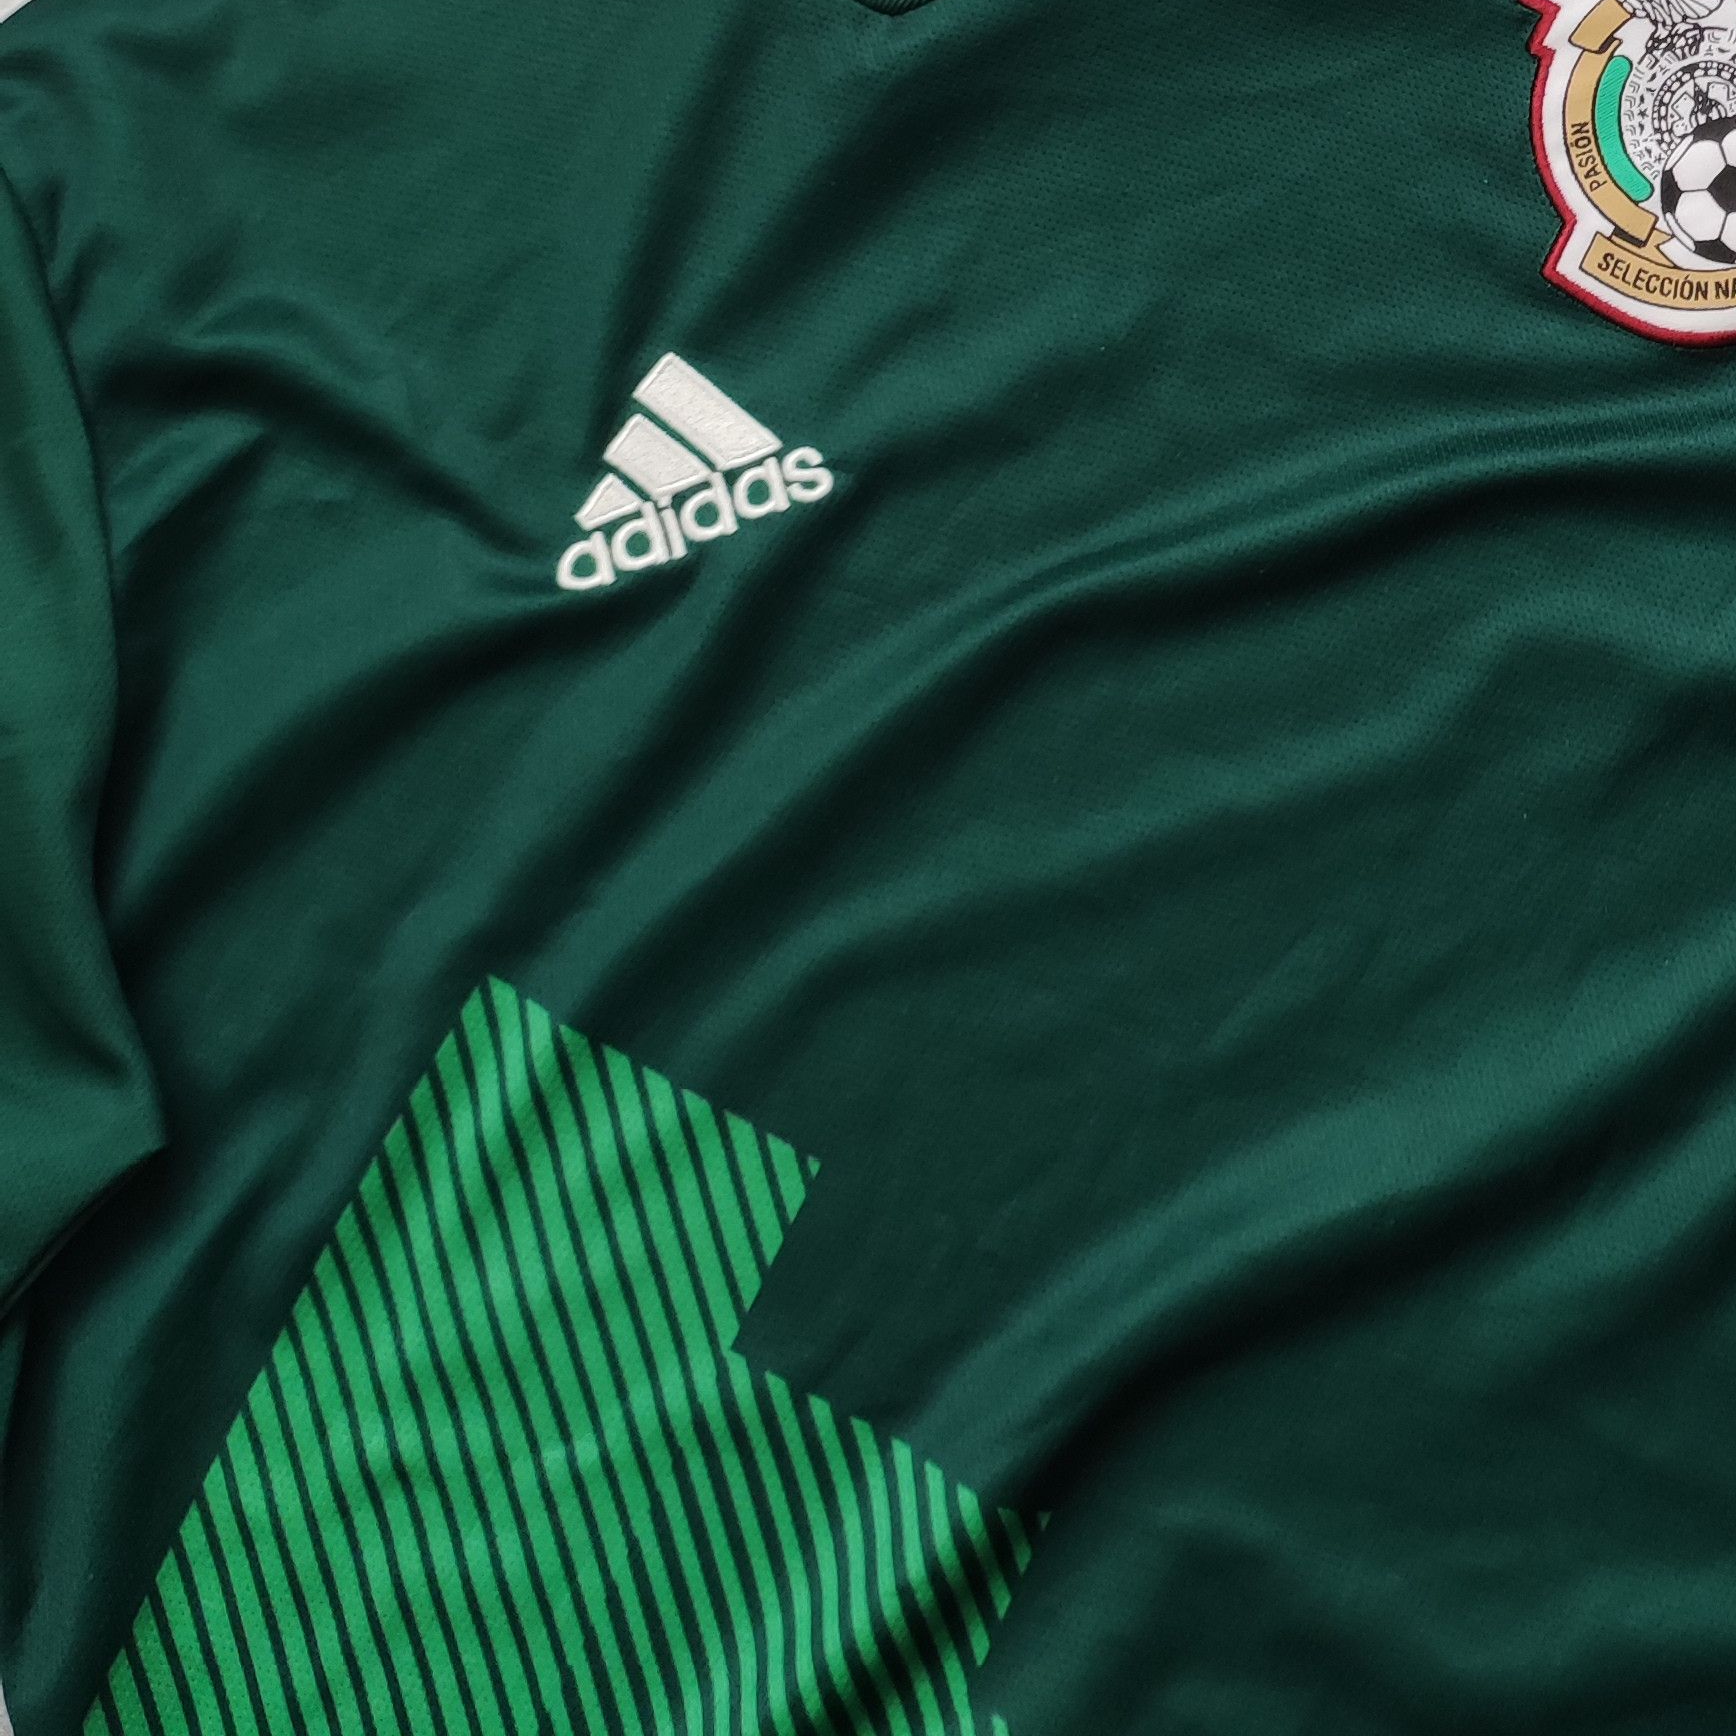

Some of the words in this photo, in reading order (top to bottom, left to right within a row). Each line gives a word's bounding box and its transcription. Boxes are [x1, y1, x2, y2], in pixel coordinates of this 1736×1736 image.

[1570, 121, 1607, 193] PASIÓN
[1597, 252, 1709, 301] SELECCIÓN
[556, 446, 834, 590] adidas
